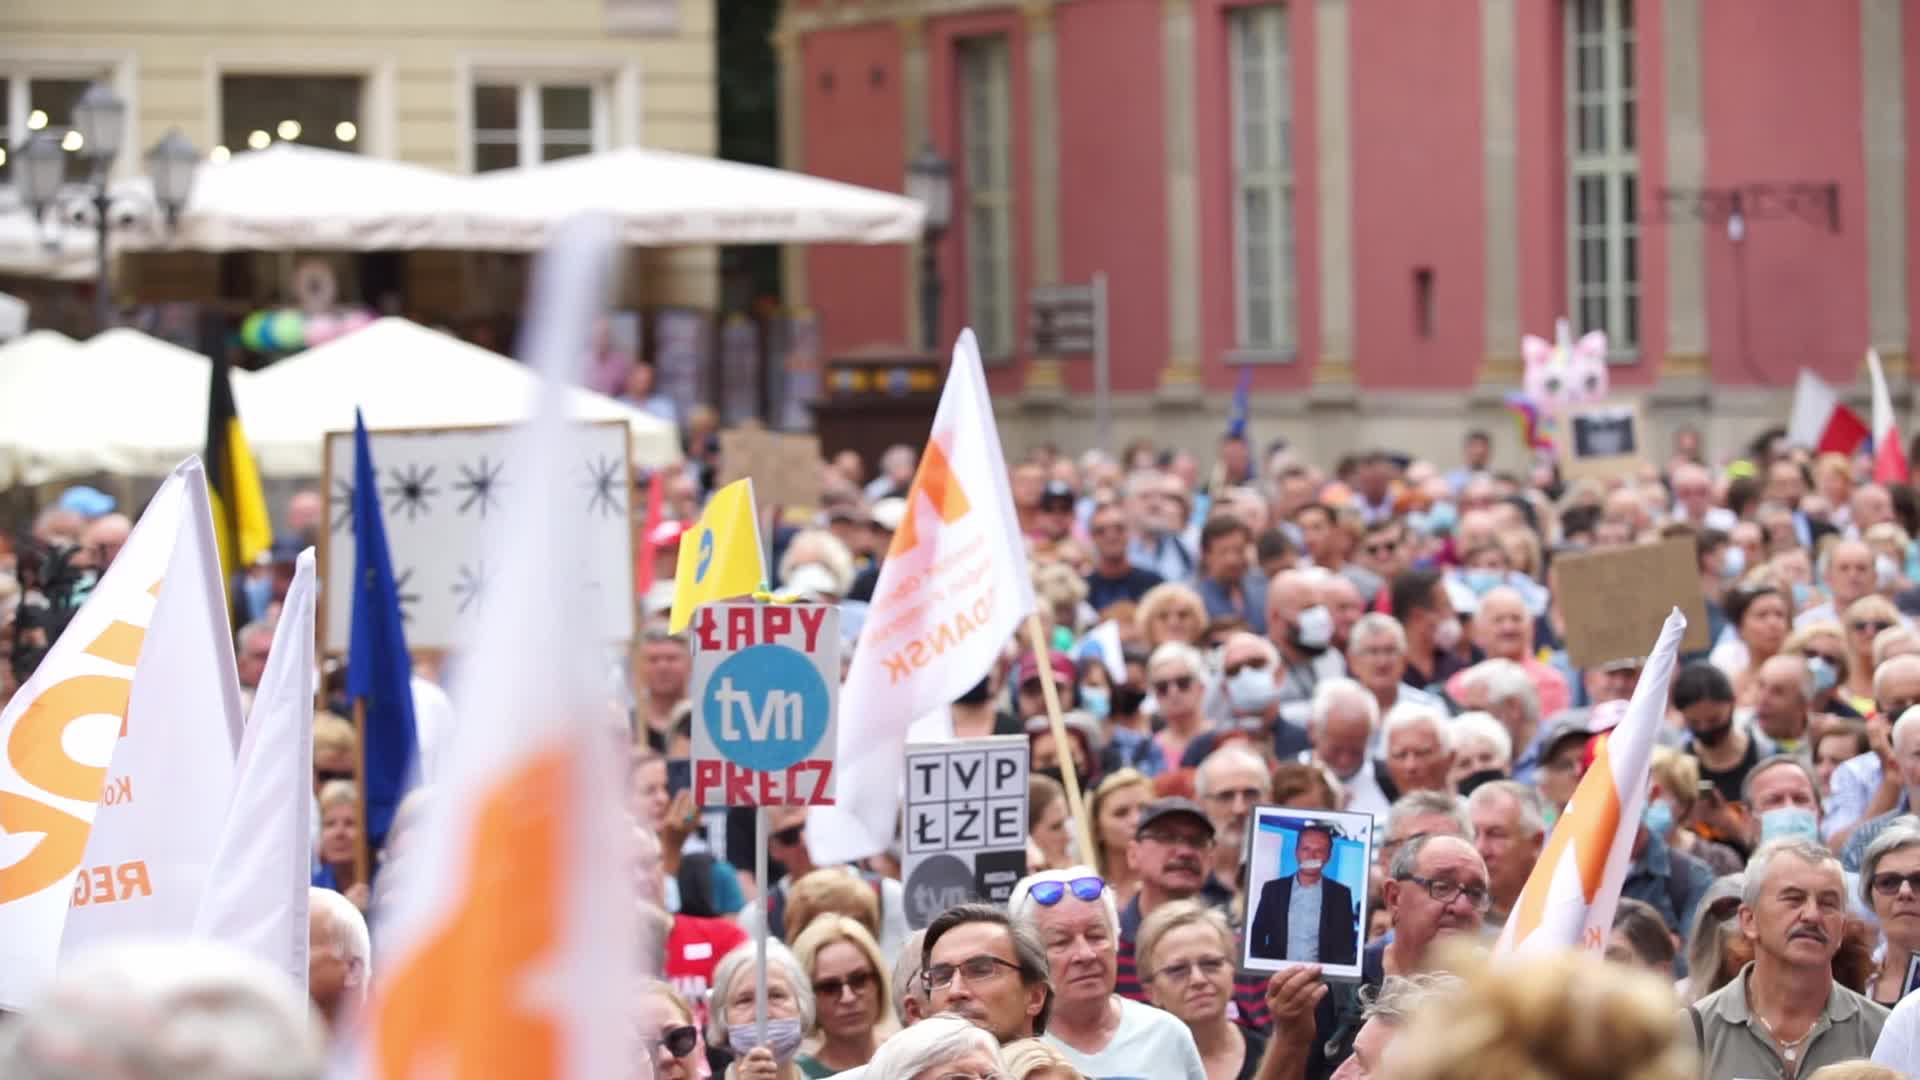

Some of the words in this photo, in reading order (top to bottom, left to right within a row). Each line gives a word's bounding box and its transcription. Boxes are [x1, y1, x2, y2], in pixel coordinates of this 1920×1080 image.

[696, 607, 826, 653] ŁAPY
[713, 676, 804, 741] tvn
[694, 759, 836, 807] PRECZ
[915, 758, 1017, 796] TVP
[914, 800, 1019, 845] ŁŻE
